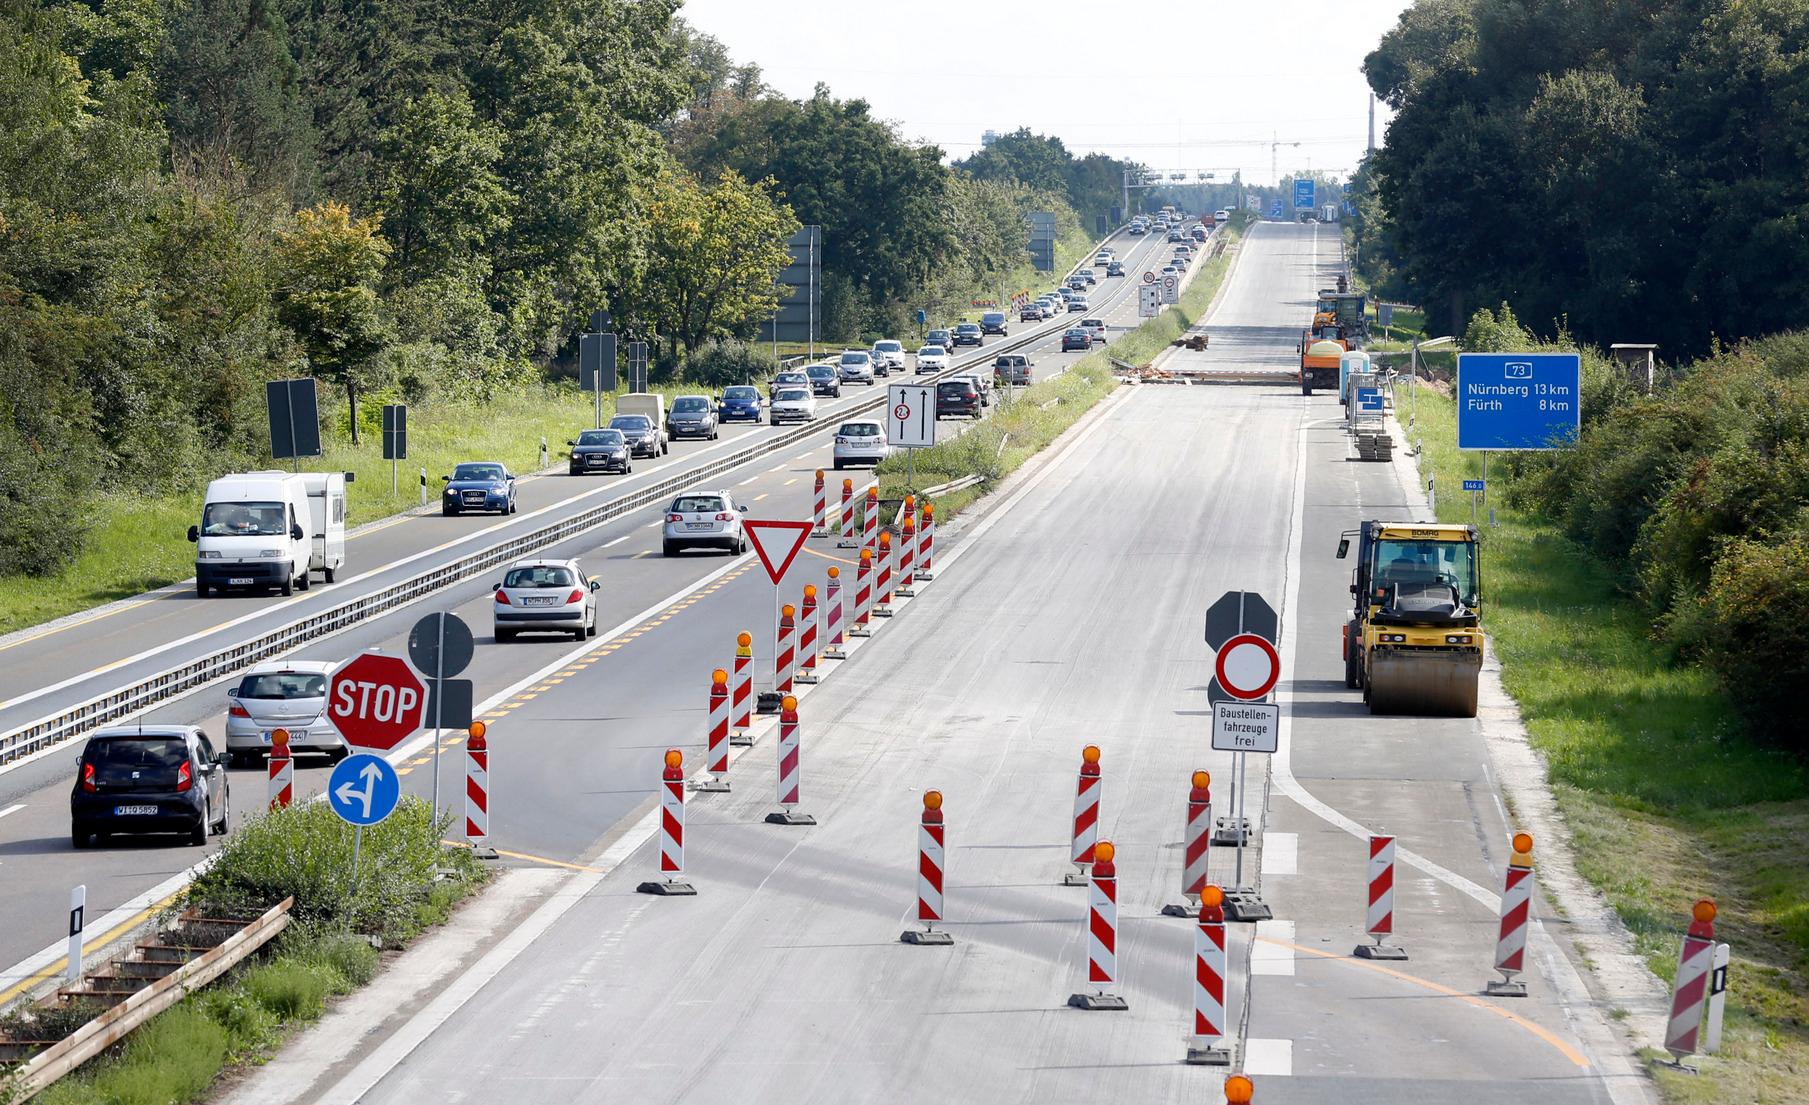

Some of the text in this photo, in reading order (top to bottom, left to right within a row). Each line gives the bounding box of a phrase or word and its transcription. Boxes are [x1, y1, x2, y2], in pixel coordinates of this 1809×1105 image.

[1512, 365, 1525, 376] 73
[1468, 383, 1569, 397] Nürnberg 13 km
[1468, 399, 1569, 411] Fürth 8 km
[334, 679, 418, 724] STOP
[1220, 707, 1272, 720] Baustellen-
[1224, 721, 1268, 736] fahrzeuge
[1235, 736, 1255, 747] frei
